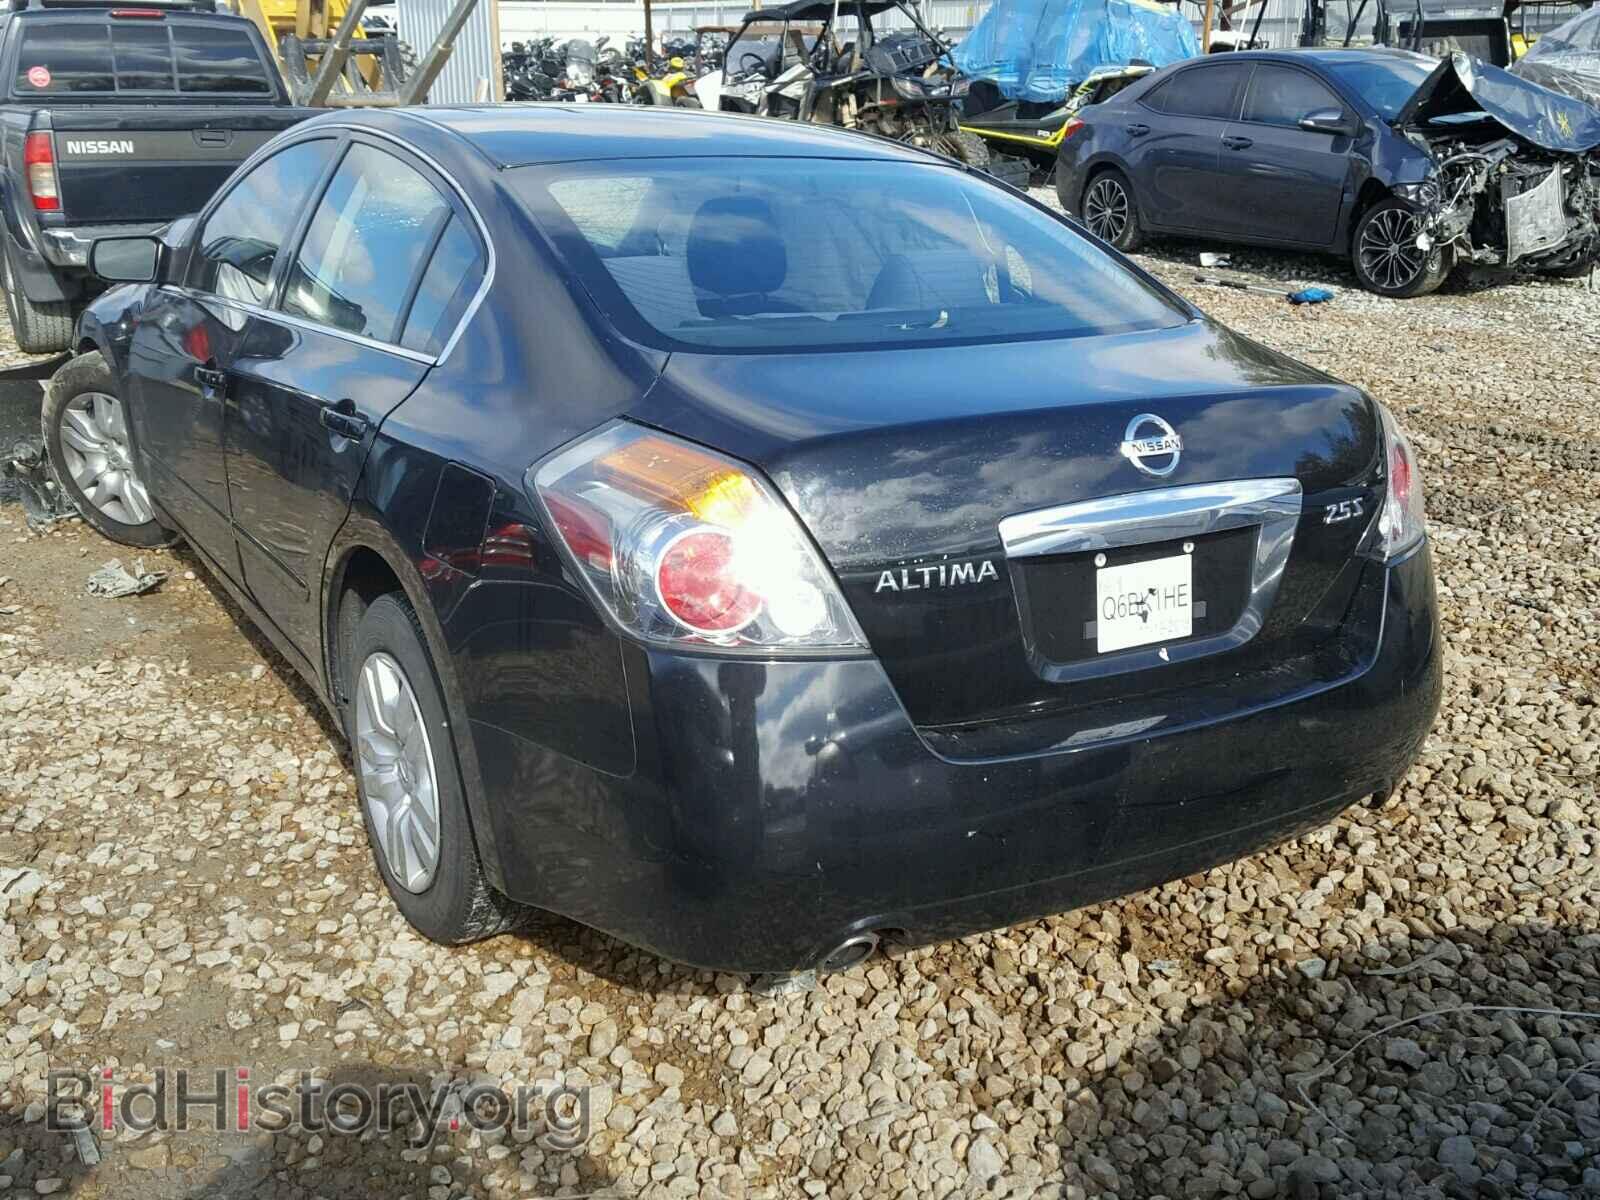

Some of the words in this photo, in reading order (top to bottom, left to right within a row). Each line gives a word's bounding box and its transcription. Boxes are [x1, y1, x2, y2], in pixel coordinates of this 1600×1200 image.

[66, 140, 134, 153] NISSAN
[1132, 438, 1181, 453] NISSAN
[875, 560, 999, 592] ALTIMA
